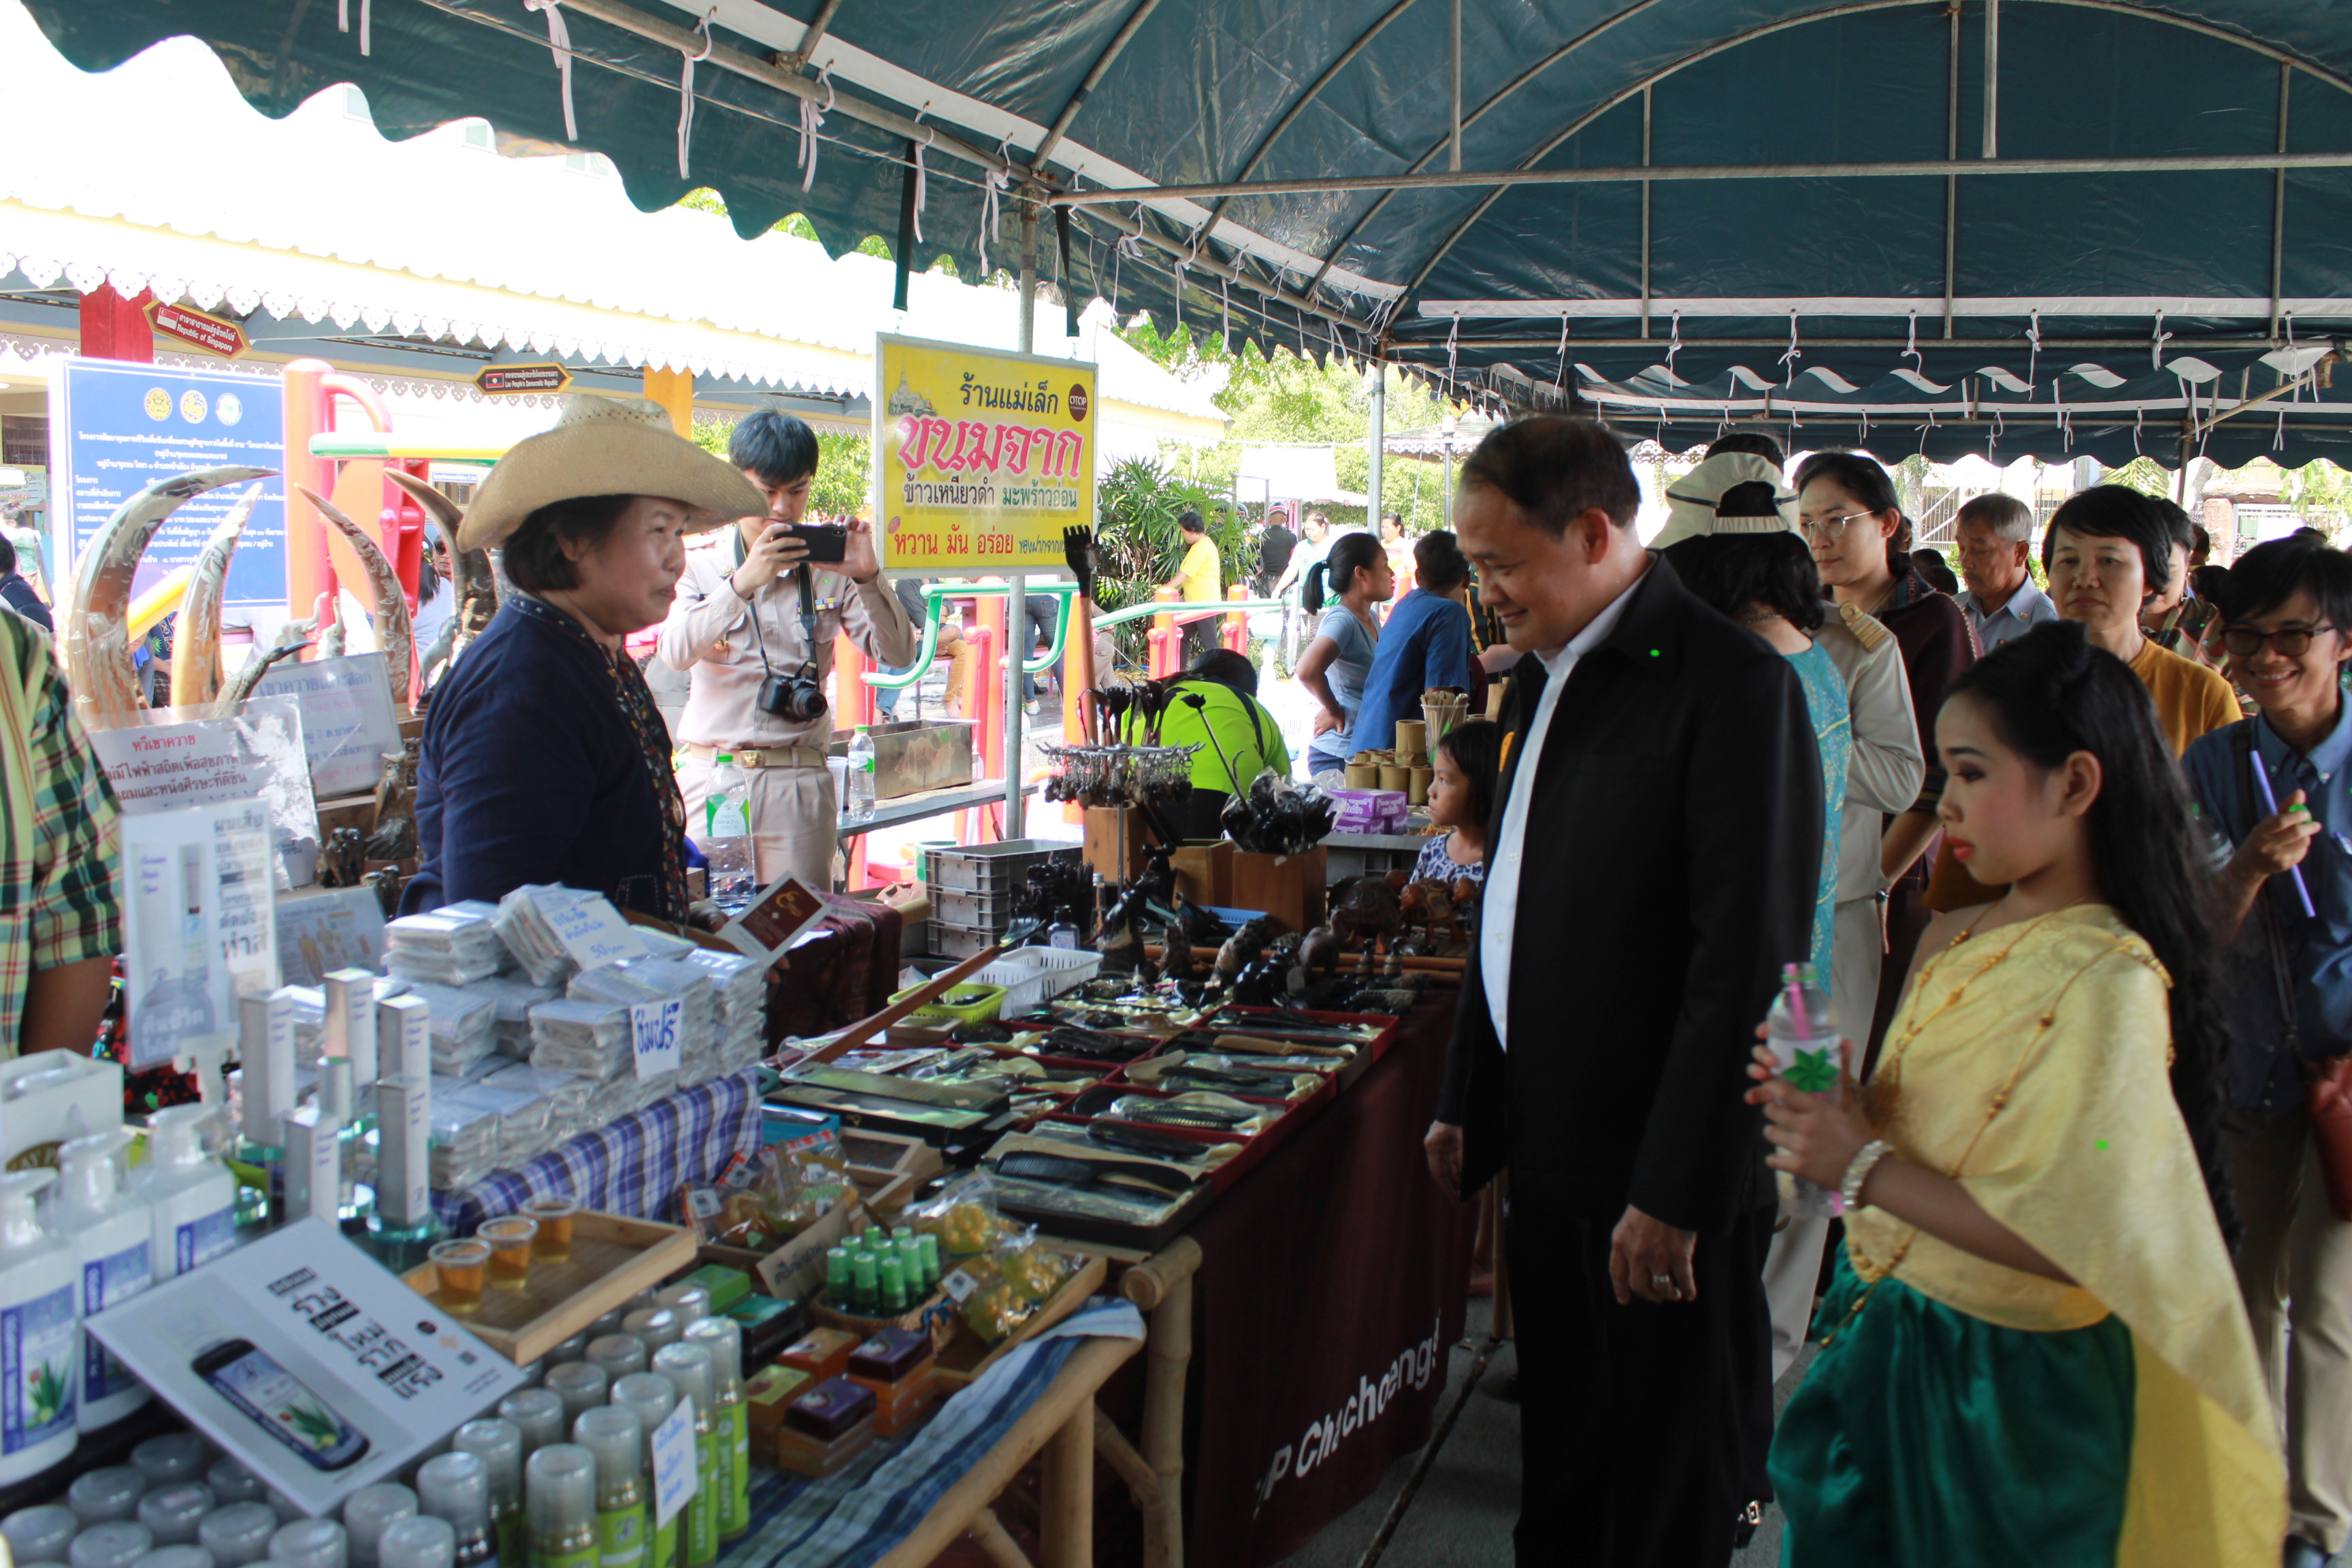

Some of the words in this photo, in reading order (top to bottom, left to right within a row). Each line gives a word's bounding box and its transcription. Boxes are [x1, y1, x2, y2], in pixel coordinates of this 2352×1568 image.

[177, 325, 199, 339] Republic
[200, 333, 207, 342] of
[207, 335, 233, 352] Singapore
[544, 379, 558, 387] Republic
[960, 372, 1058, 414] ร้านแม่เล็ก
[1069, 395, 1087, 406] OTOP
[897, 415, 1083, 478] ขนมจาก
[904, 473, 994, 504] ข้าวเหนียวดำ
[1002, 479, 1077, 508] มะพร้าวอ่อน
[894, 533, 938, 555] หวาน
[947, 525, 968, 555] มัน
[977, 529, 1014, 555] อร่อย
[132, 734, 197, 752] หวีเขาควาย
[359, 1337, 406, 1367] ราก
[393, 1365, 443, 1400] แรง
